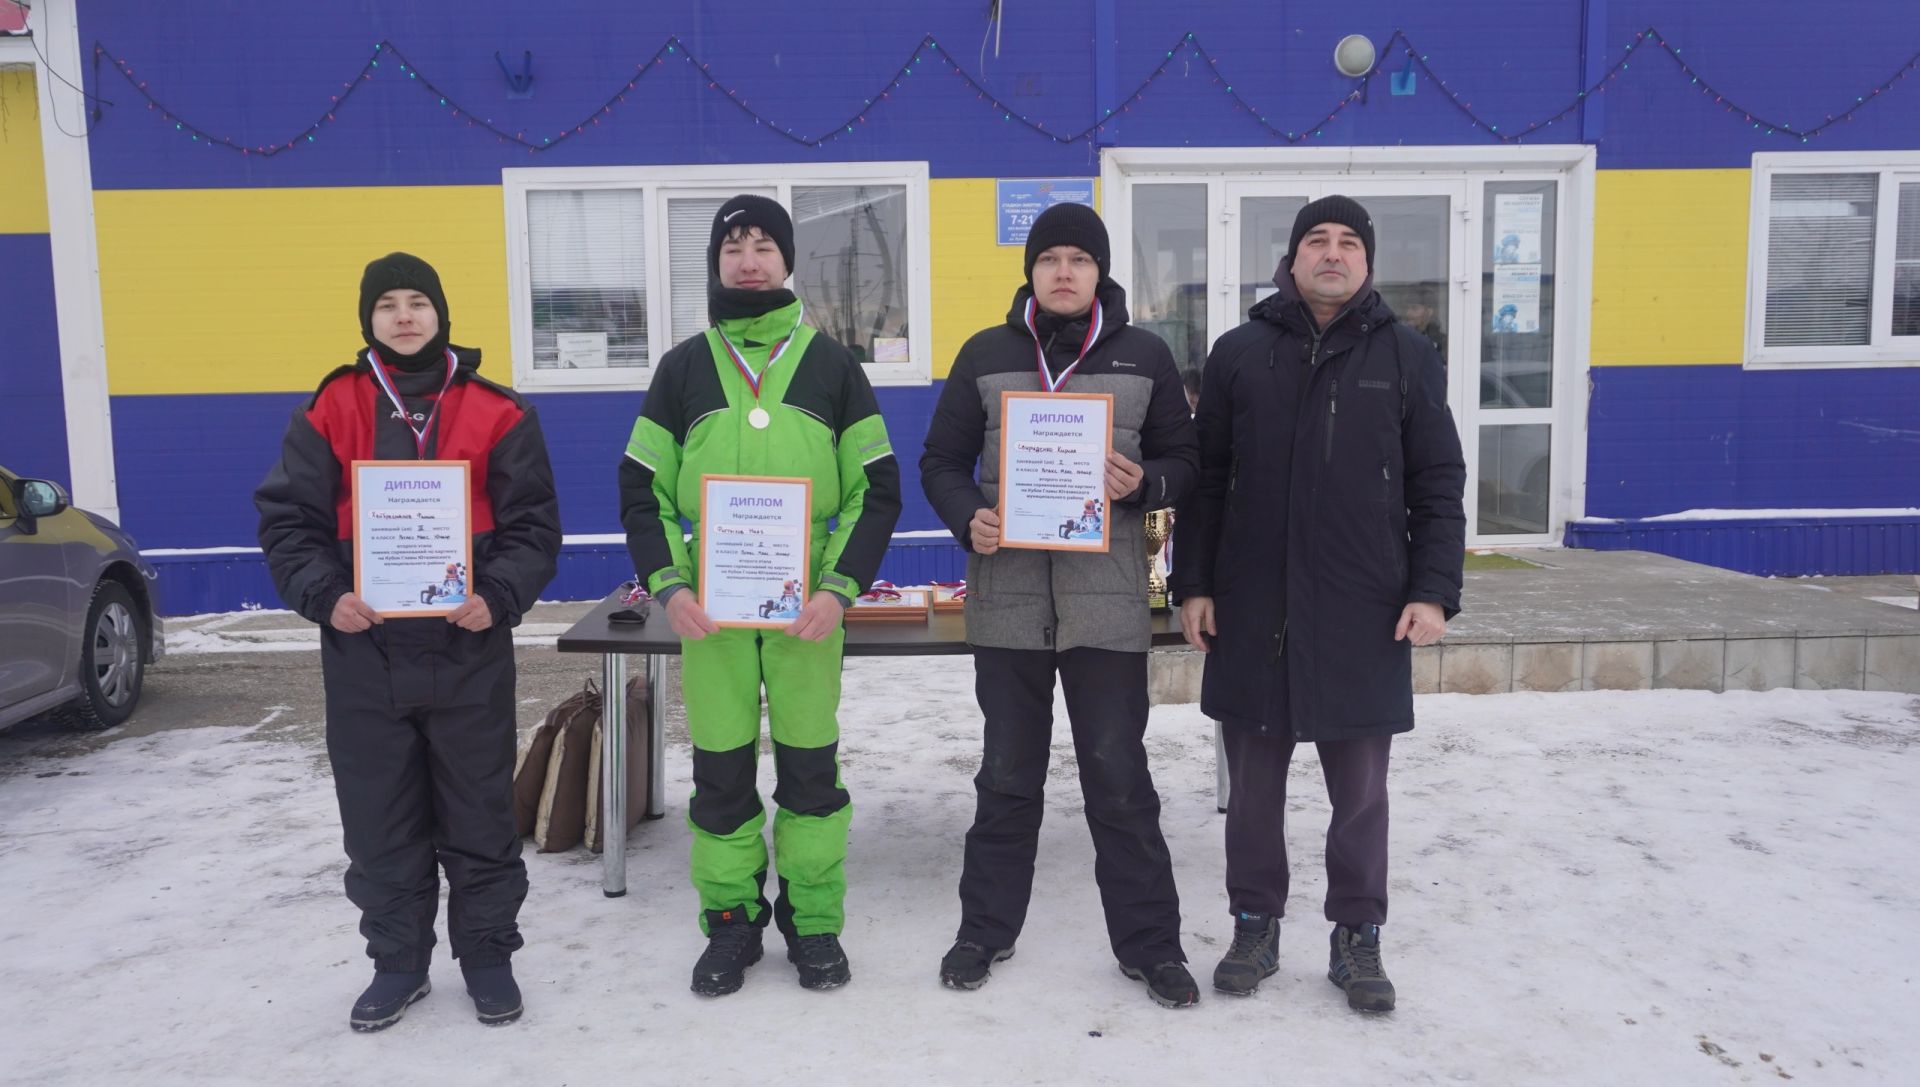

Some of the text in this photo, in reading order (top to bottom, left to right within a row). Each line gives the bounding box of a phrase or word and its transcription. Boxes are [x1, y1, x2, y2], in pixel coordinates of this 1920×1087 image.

[1011, 215, 1034, 225] 7-21
[1030, 413, 1084, 424] ДИПЛОМ
[384, 480, 442, 491] ДИПЛОМ
[729, 497, 783, 508] ДИПЛОМ
